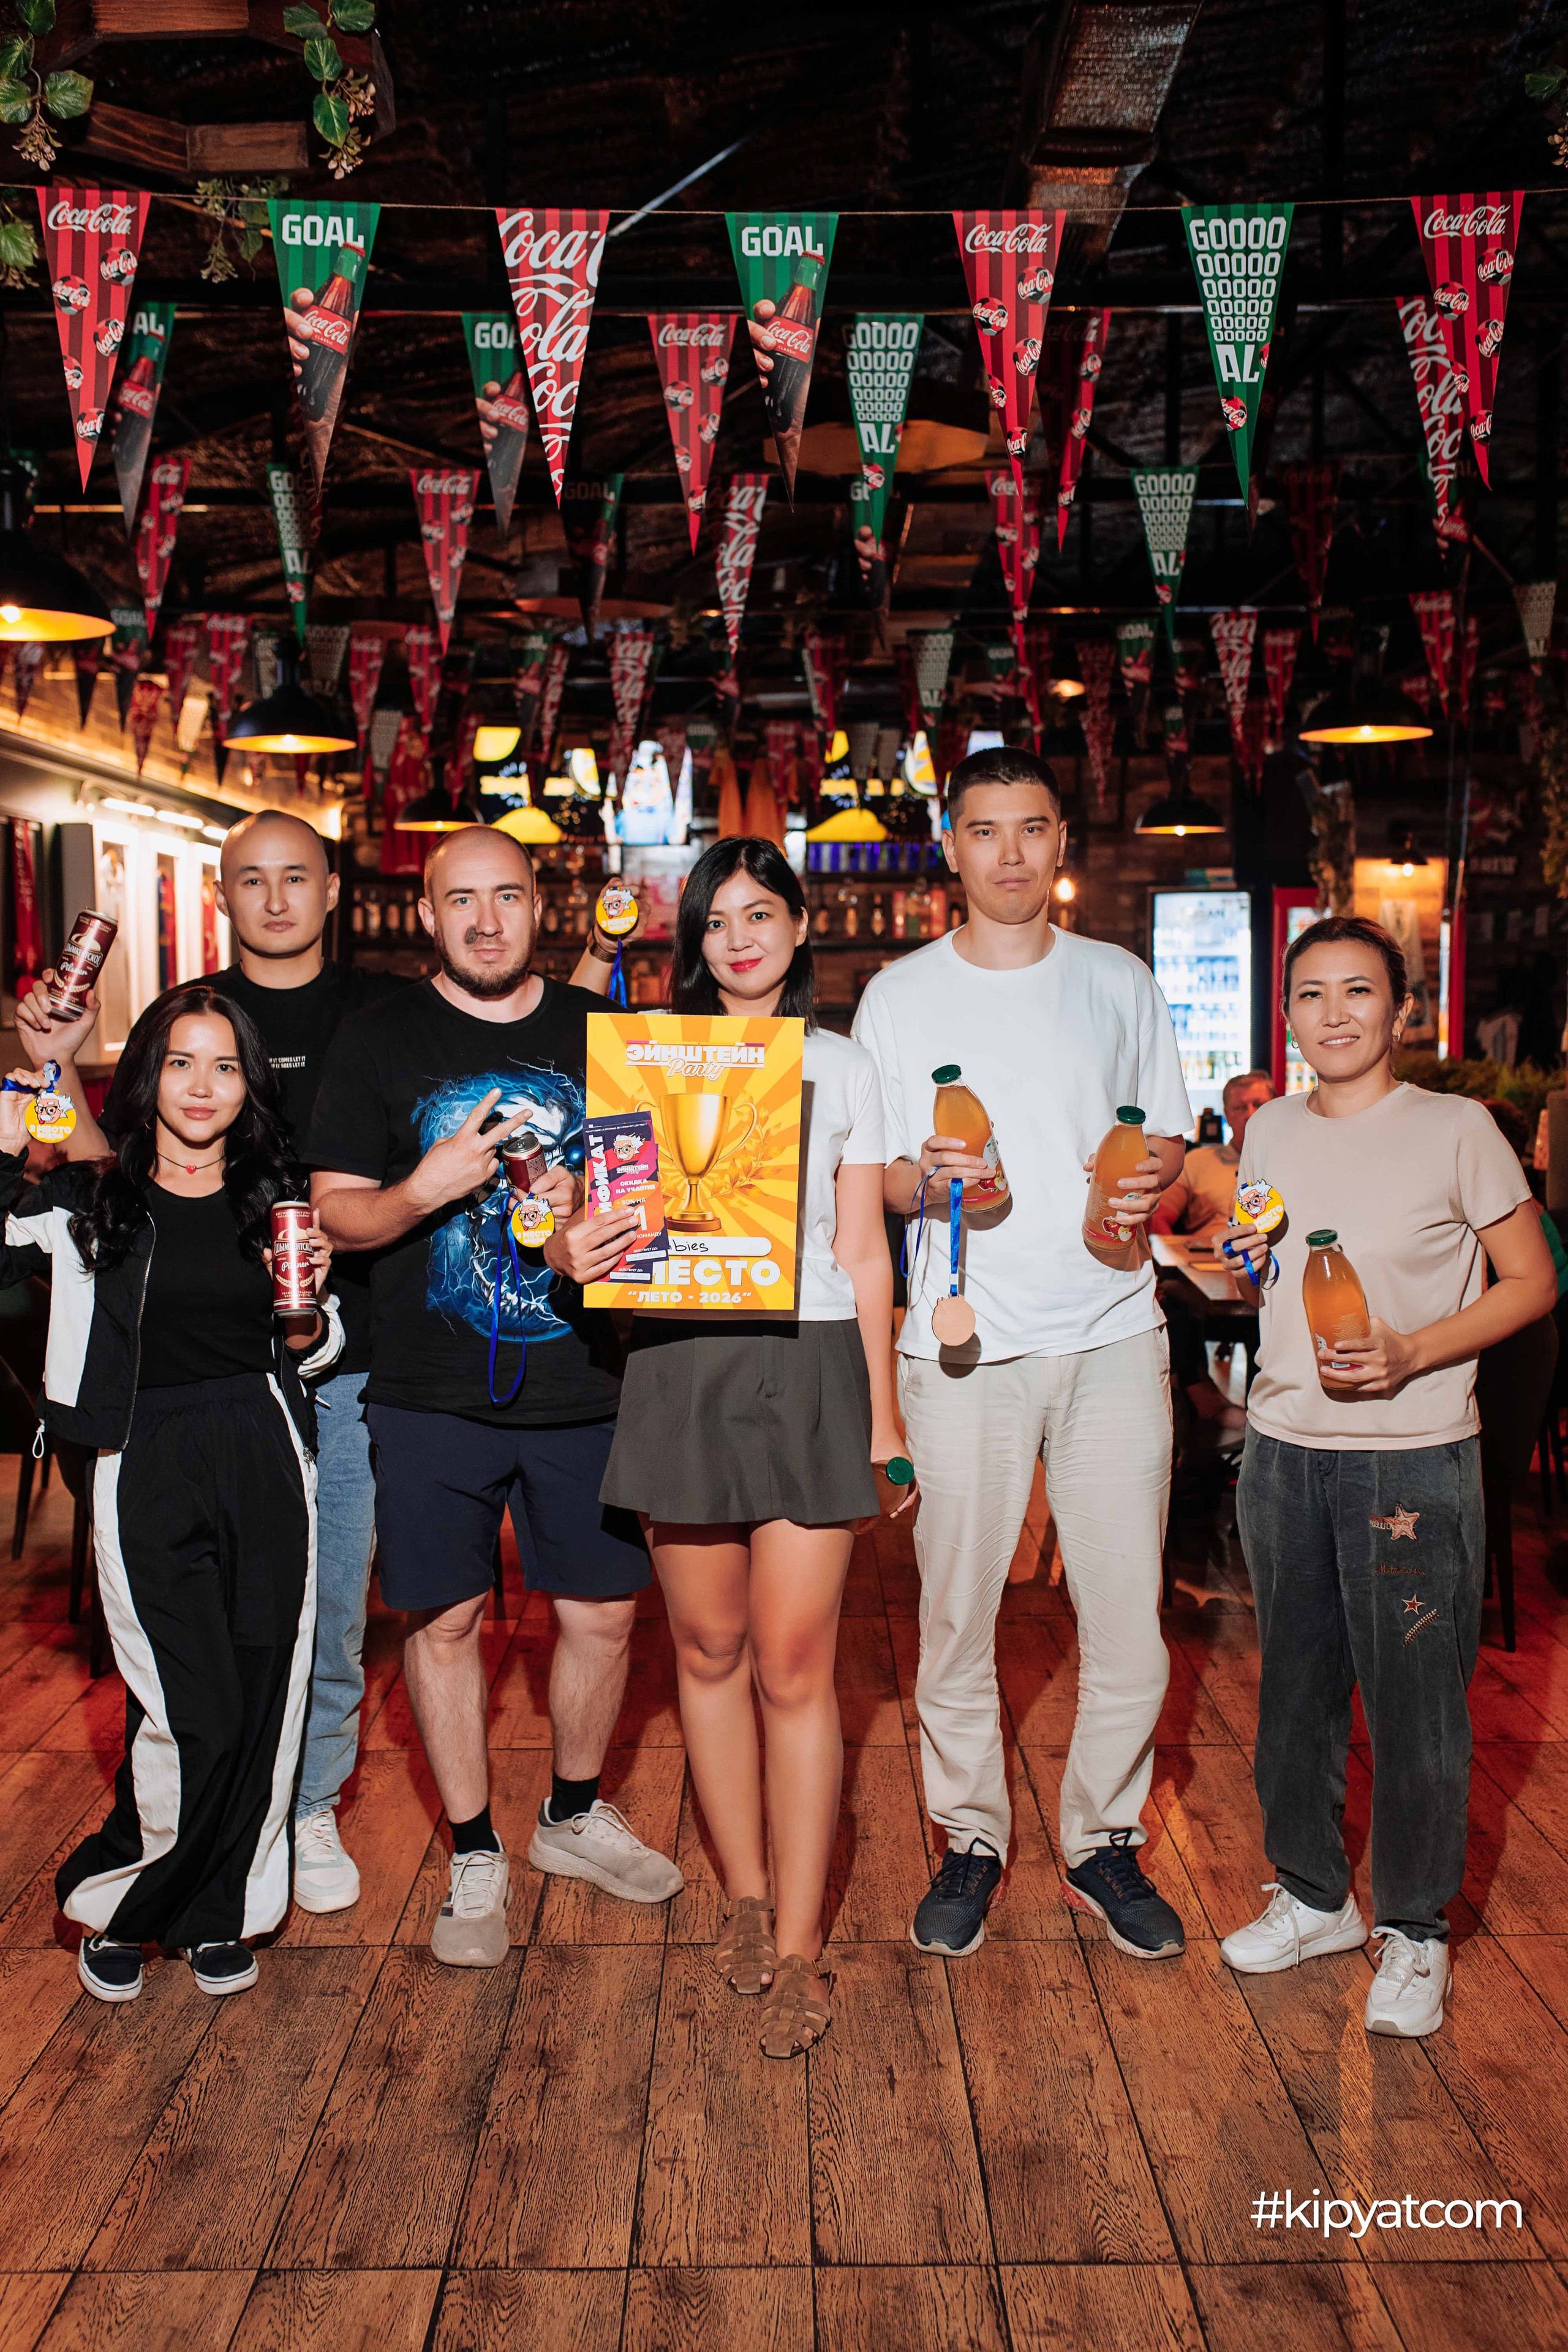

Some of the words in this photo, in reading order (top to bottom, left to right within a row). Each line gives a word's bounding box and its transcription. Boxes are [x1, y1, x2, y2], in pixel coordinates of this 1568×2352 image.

[48, 200, 137, 235] Coca-Cola
[282, 214, 364, 247] GOAL
[1423, 205, 1511, 239] Coca-Cola
[741, 225, 824, 257] GOAL
[965, 223, 1053, 254] Coca-Cola
[1189, 216, 1287, 251] GOOOO
[132, 312, 165, 336] AL
[658, 322, 728, 348] Coca-Cola
[777, 345, 797, 355] CLASSIC
[1215, 344, 1260, 383] AL
[859, 423, 895, 453] AL
[1152, 552, 1180, 576] AL
[626, 1041, 765, 1065] ЭЙНШТЕЙН
[666, 1058, 728, 1082] Party
[620, 1178, 648, 1187] СКИДКА
[634, 1205, 648, 1231] 1
[281, 1261, 310, 1272] Piner
